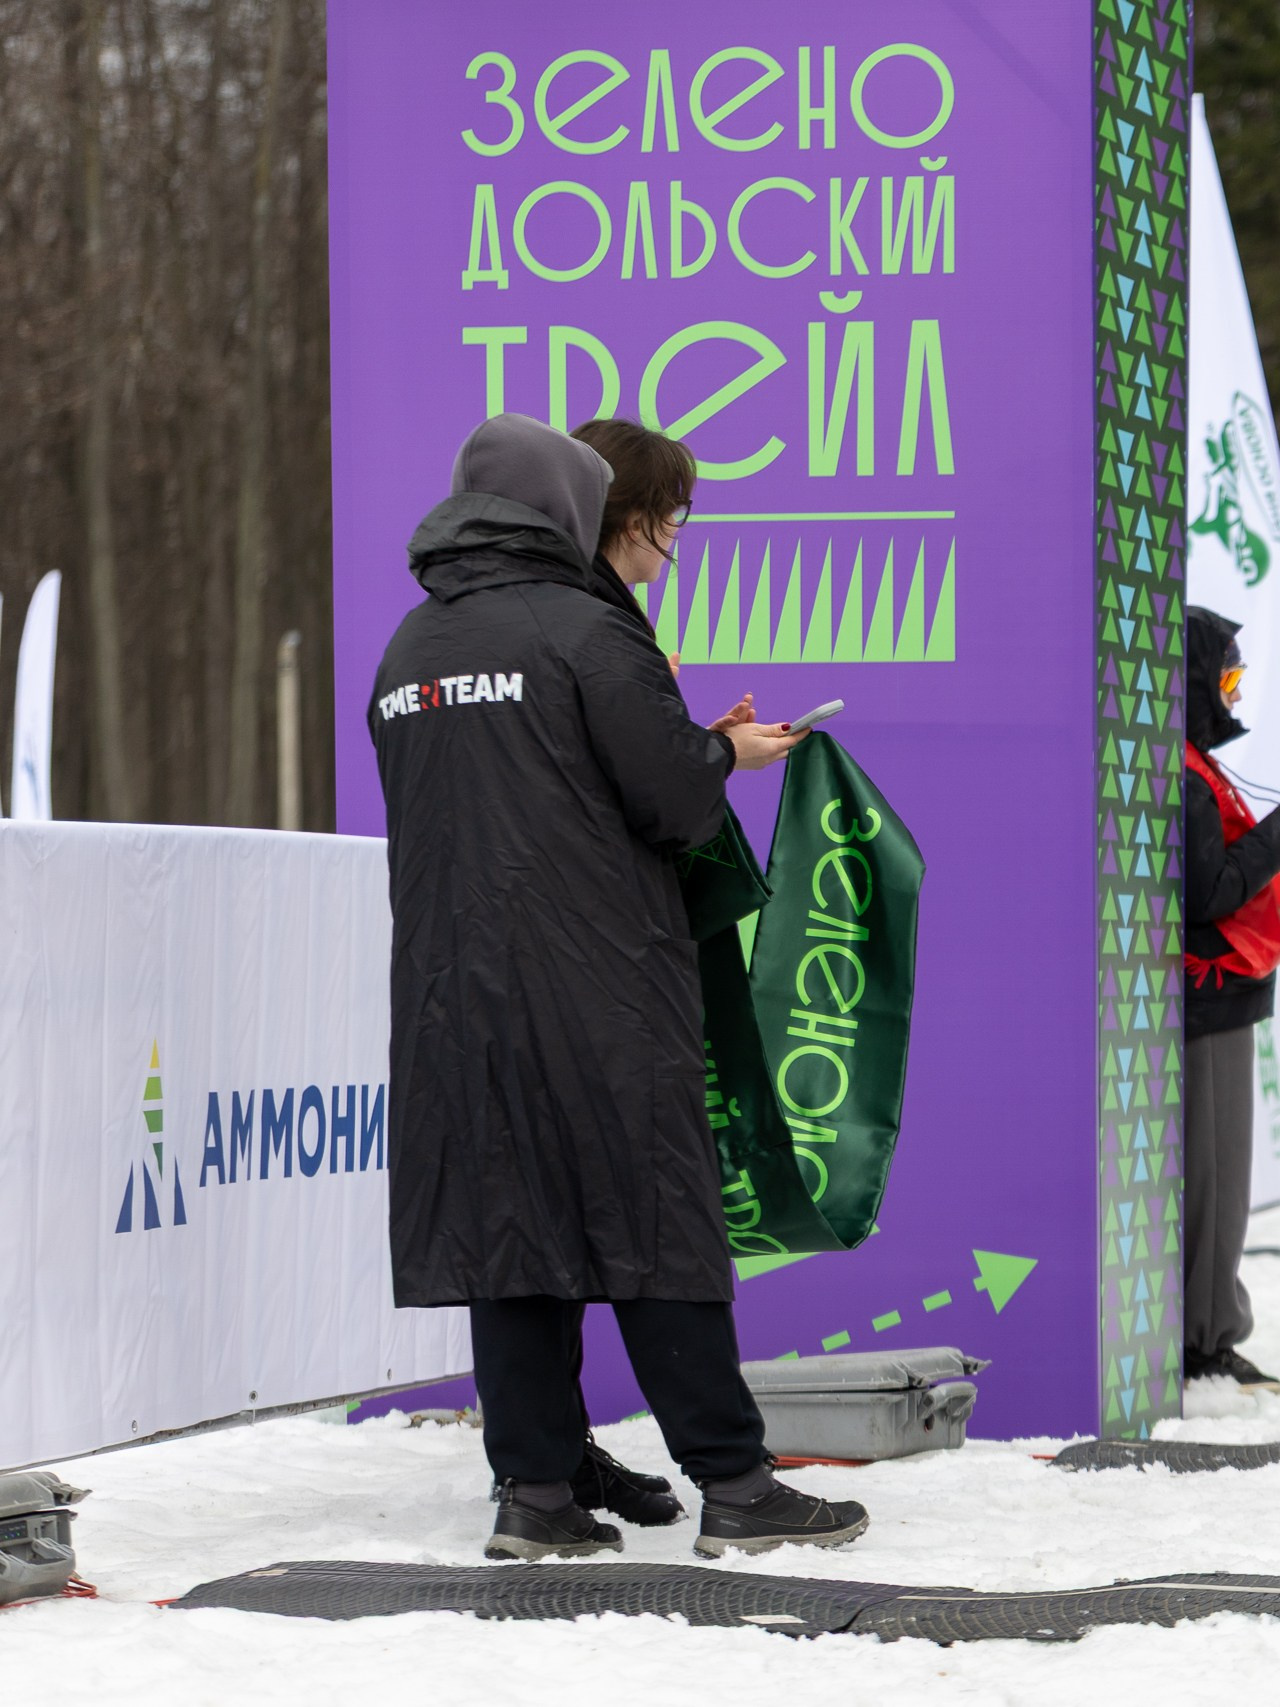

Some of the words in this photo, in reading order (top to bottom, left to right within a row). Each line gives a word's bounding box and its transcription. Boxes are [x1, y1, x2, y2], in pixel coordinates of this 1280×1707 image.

[461, 156, 956, 290] ДОЛЬСКИЙ
[462, 290, 956, 481] ТРЕЙЛ
[199, 1083, 390, 1188] АММОНИ
